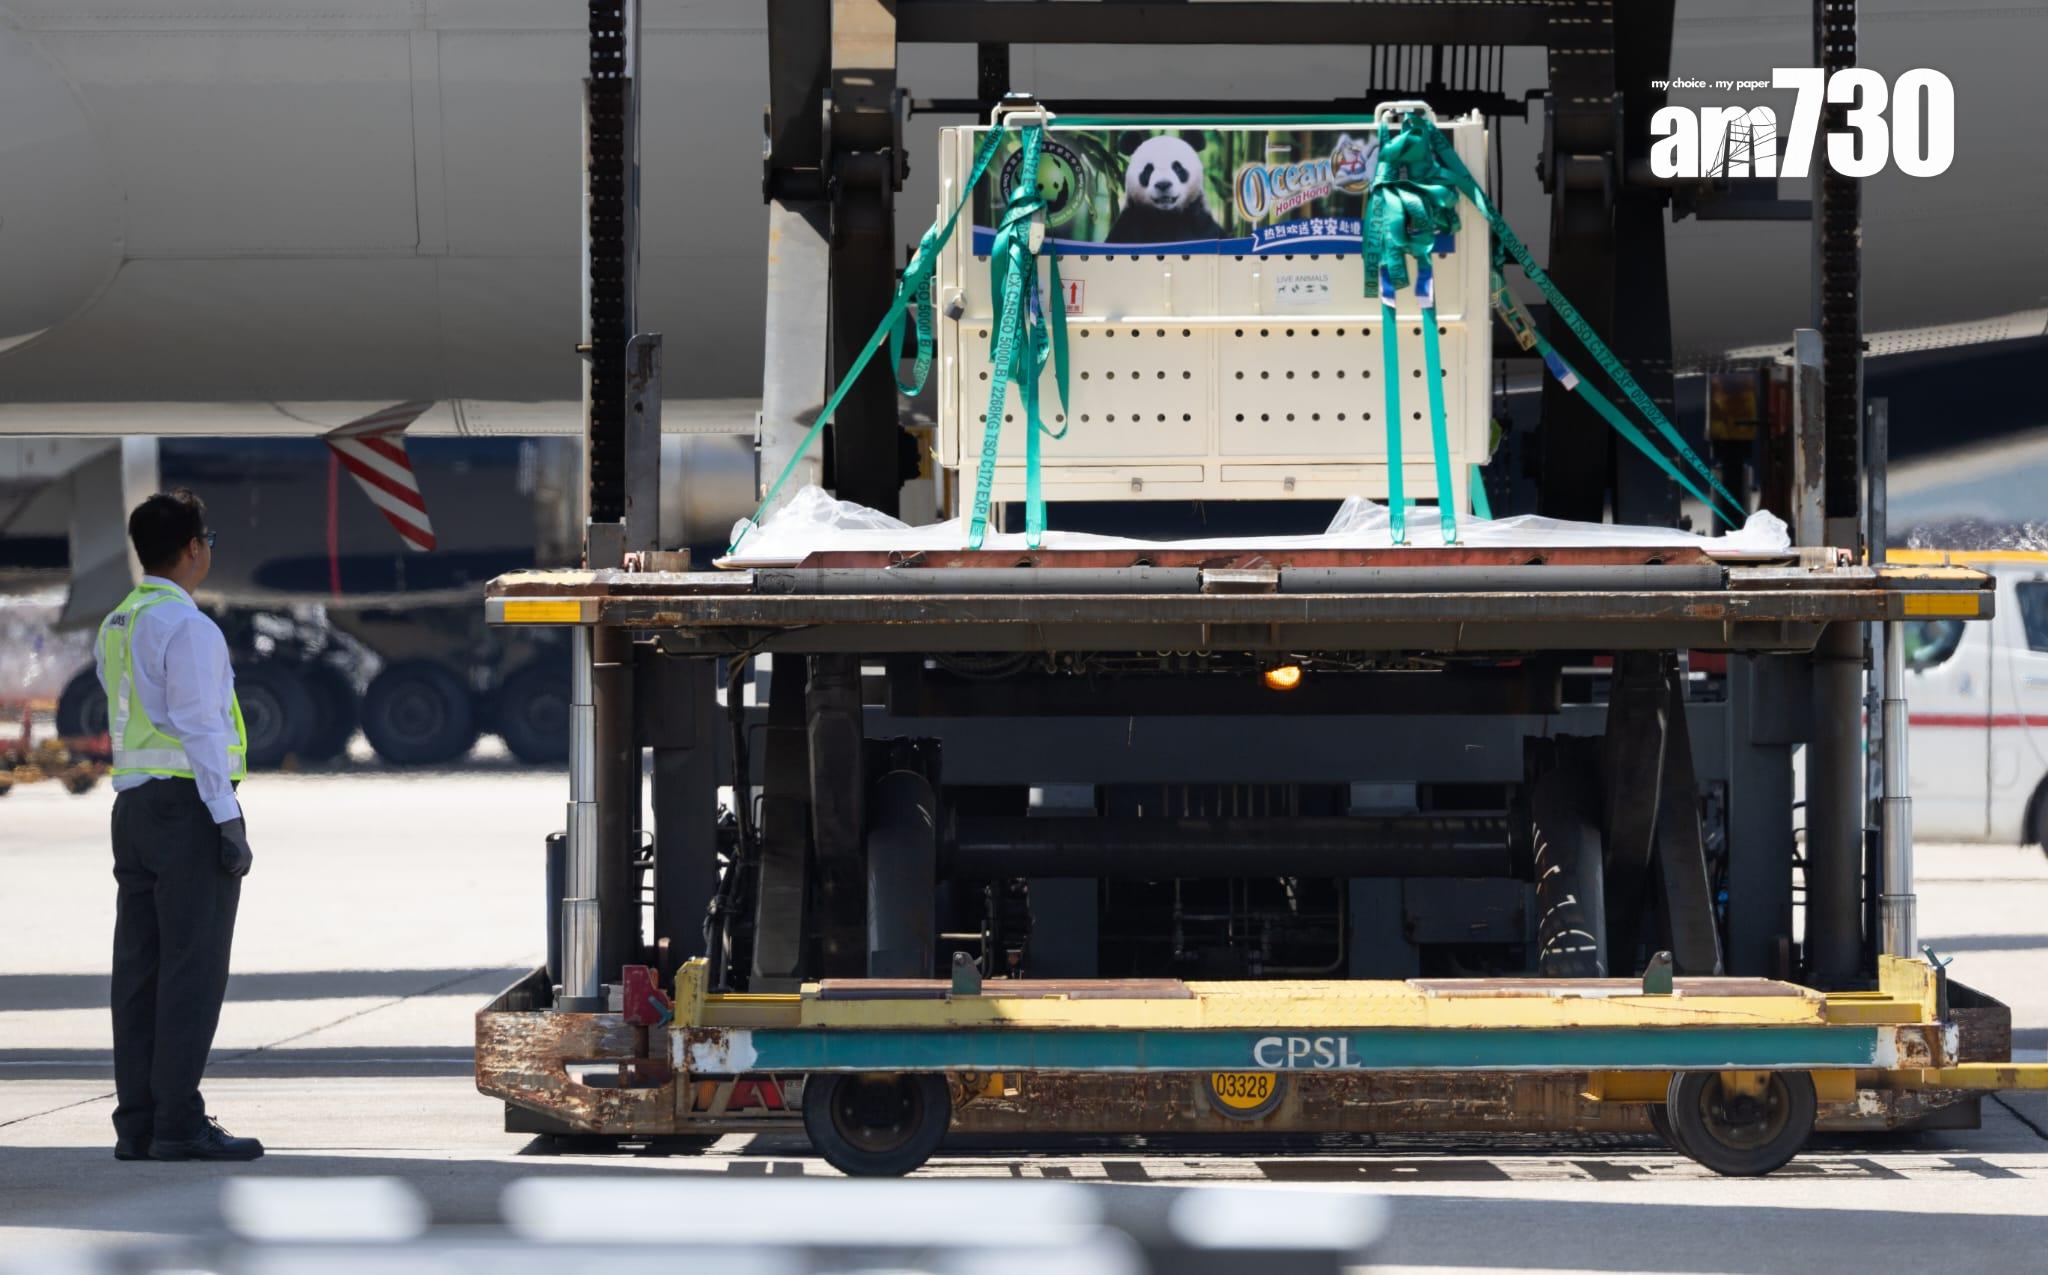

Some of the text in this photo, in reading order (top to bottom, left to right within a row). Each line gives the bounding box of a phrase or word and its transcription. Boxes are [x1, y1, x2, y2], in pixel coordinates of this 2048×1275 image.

[1234, 158, 1333, 222] Ocean
[1276, 186, 1331, 216] Hong Hong
[1008, 271, 1022, 289] CX
[1276, 274, 1329, 284] LIVE ANIMALS
[1001, 290, 1019, 335] CARGO
[995, 336, 1012, 378] 5000LB
[1569, 316, 1593, 341] TSO
[1590, 340, 1616, 367] C172
[1611, 367, 1635, 389] EXP
[986, 386, 1005, 430] 2268KG
[982, 433, 999, 457] TSO
[977, 459, 995, 489] C172
[975, 490, 990, 515] EXP
[1253, 1036, 1361, 1069] CPSL
[1216, 1073, 1268, 1099] 03328
